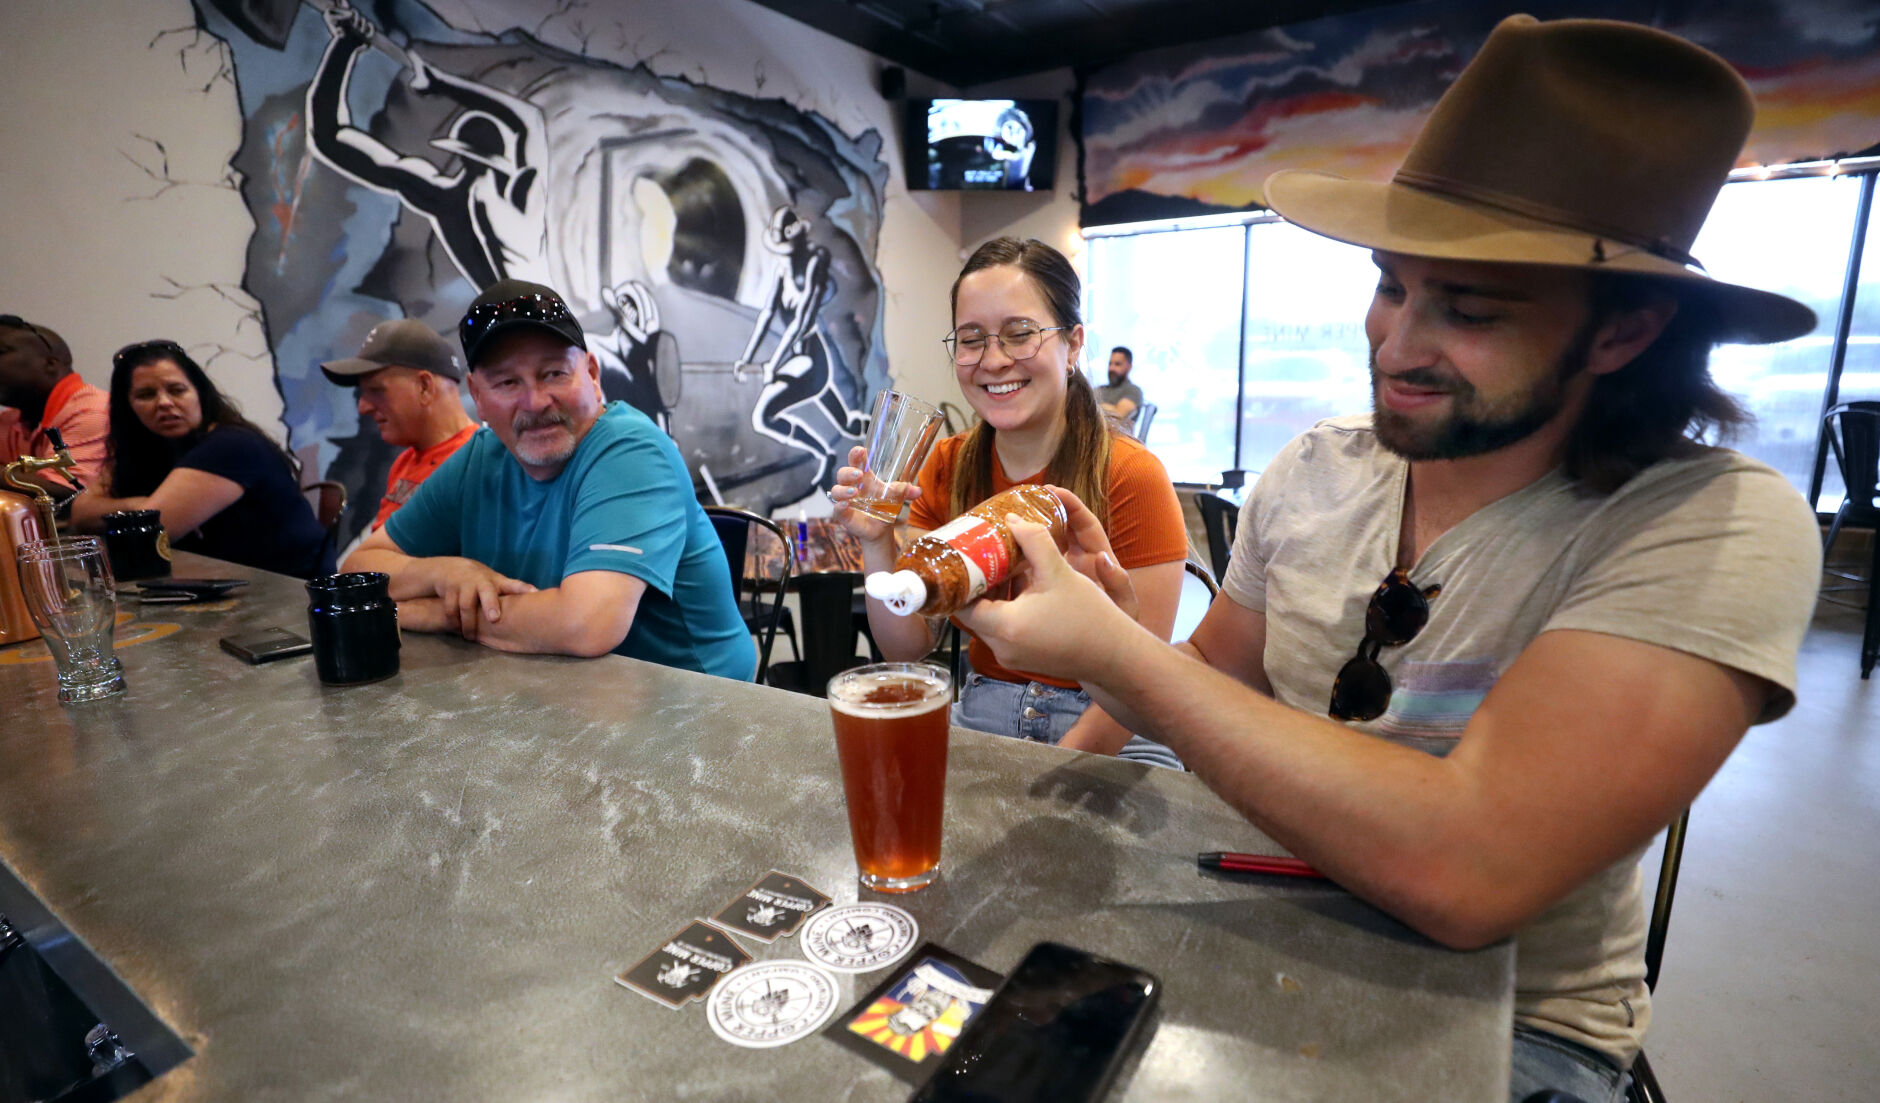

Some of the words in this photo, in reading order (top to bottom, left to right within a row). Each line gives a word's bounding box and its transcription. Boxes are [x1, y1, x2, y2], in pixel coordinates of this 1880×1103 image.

[773, 898, 814, 913] COPPER
[812, 929, 829, 957] MINE
[689, 953, 735, 975] COPPER
[834, 944, 900, 966] COPPER
[720, 988, 735, 1021] MINE
[733, 1018, 808, 1039] COPPER
